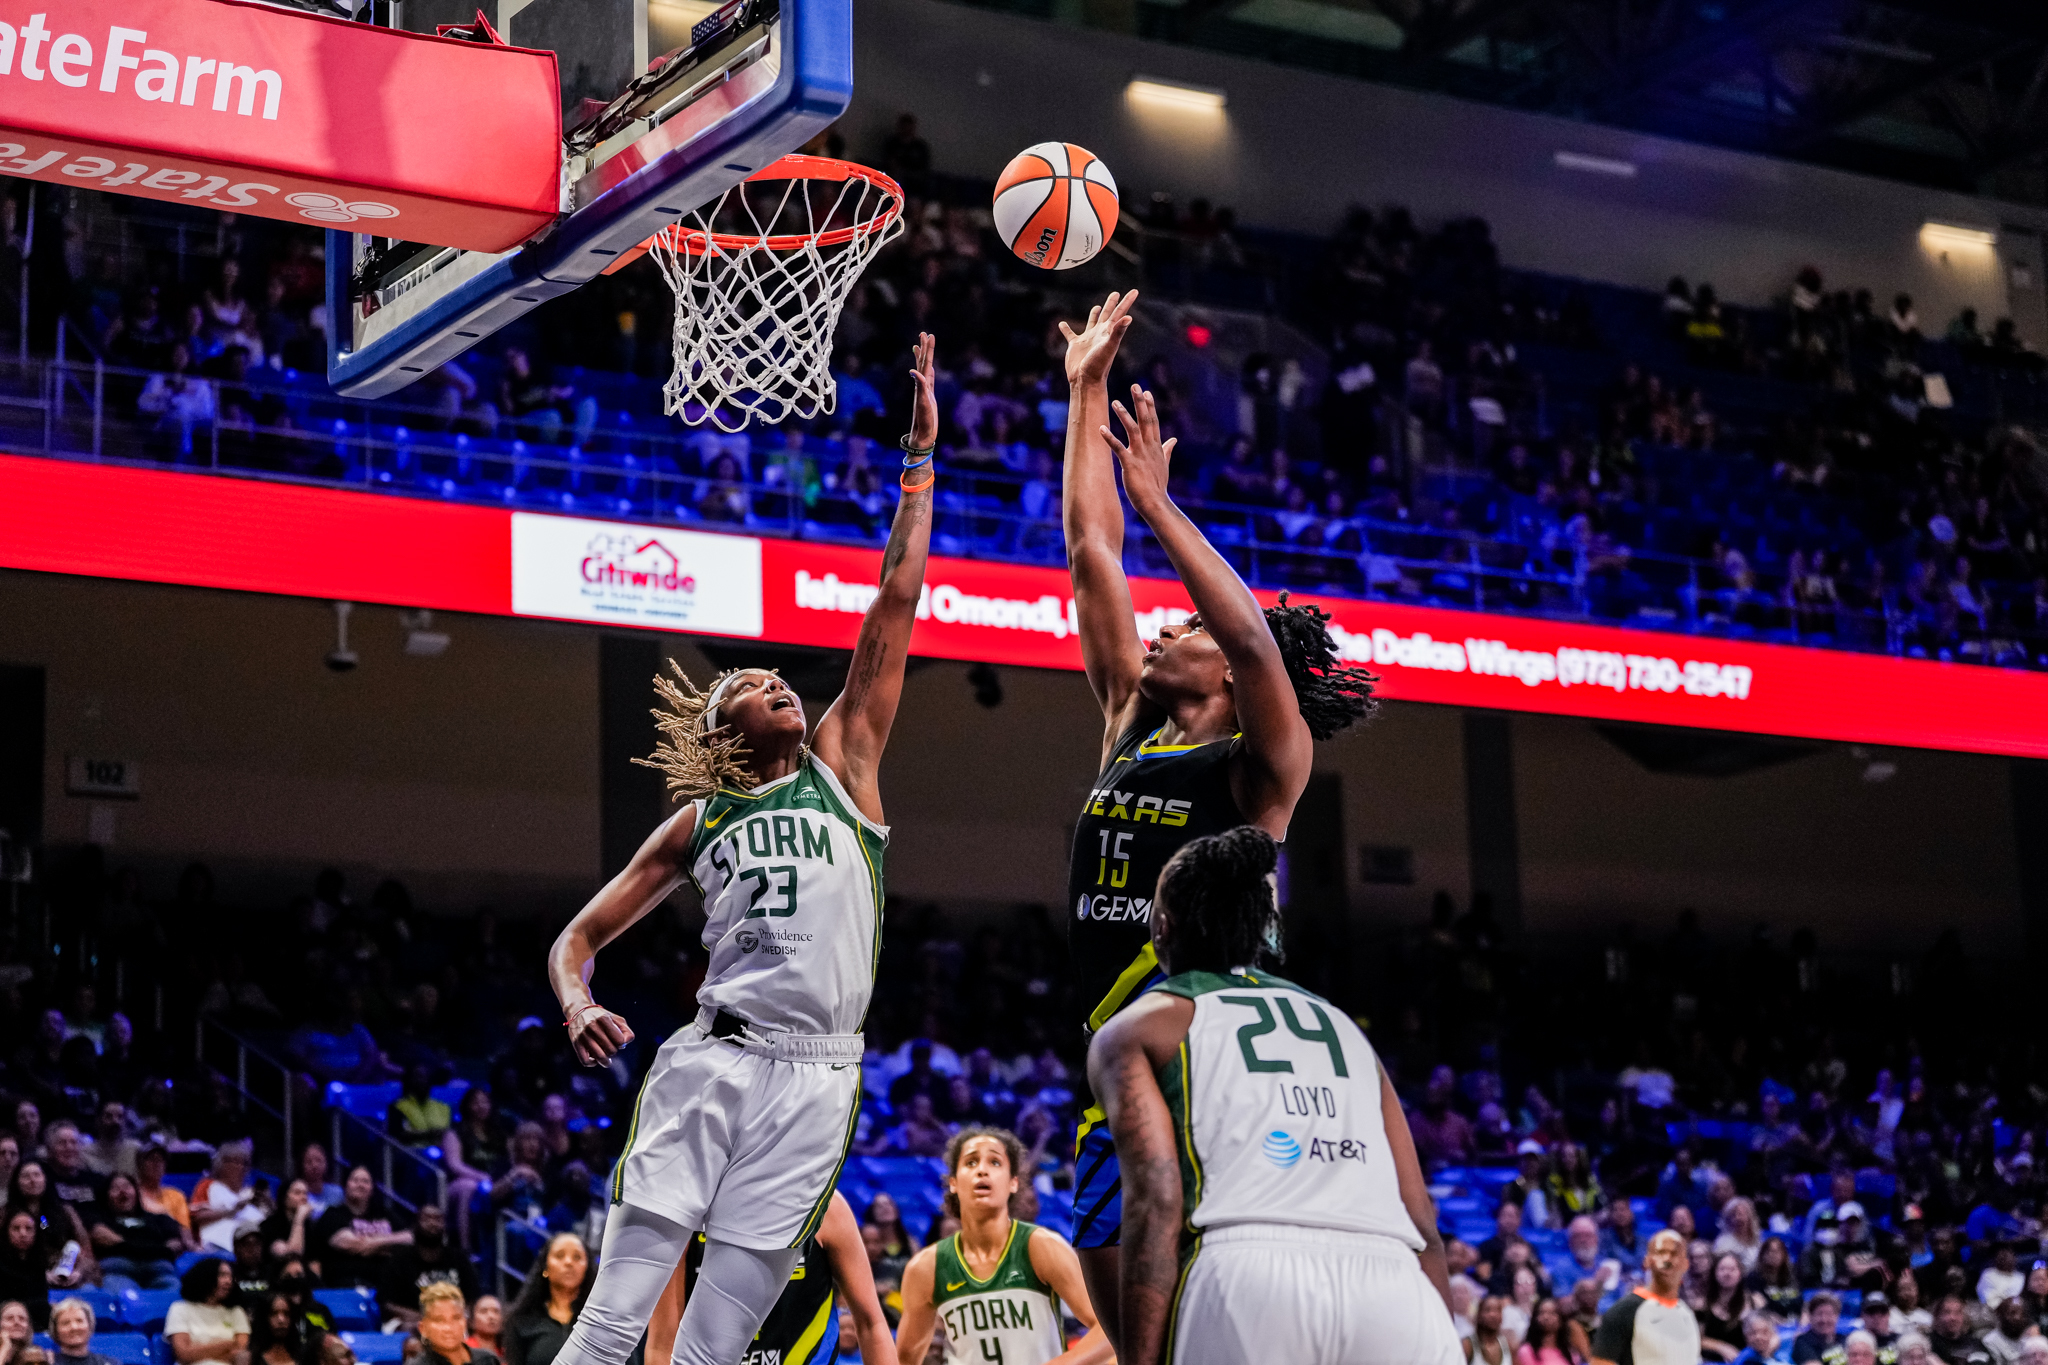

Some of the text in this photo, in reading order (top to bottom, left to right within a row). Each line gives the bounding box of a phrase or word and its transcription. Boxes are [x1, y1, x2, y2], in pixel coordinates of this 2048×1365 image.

[580, 554, 695, 594] Citiwide
[932, 585, 1068, 638] Omondi,
[1372, 629, 1467, 672] Dallas
[1466, 639, 1556, 686] Wings
[1557, 648, 1626, 691] (972)
[1626, 655, 1752, 699] 730-2547
[792, 793, 821, 802] SYMETRA
[1083, 788, 1192, 827] TEXAS
[711, 815, 835, 890] STORM
[1095, 829, 1134, 888] 15
[739, 865, 798, 919] 23
[1090, 894, 1153, 923] GEM
[758, 928, 813, 942] Providence
[761, 944, 797, 956] SWEDISH
[1217, 995, 1350, 1079] 24
[1280, 1083, 1336, 1118] LOYD
[1309, 1137, 1367, 1165] AT&T
[944, 1298, 1034, 1342] STORM
[979, 1336, 1004, 1365] 4
